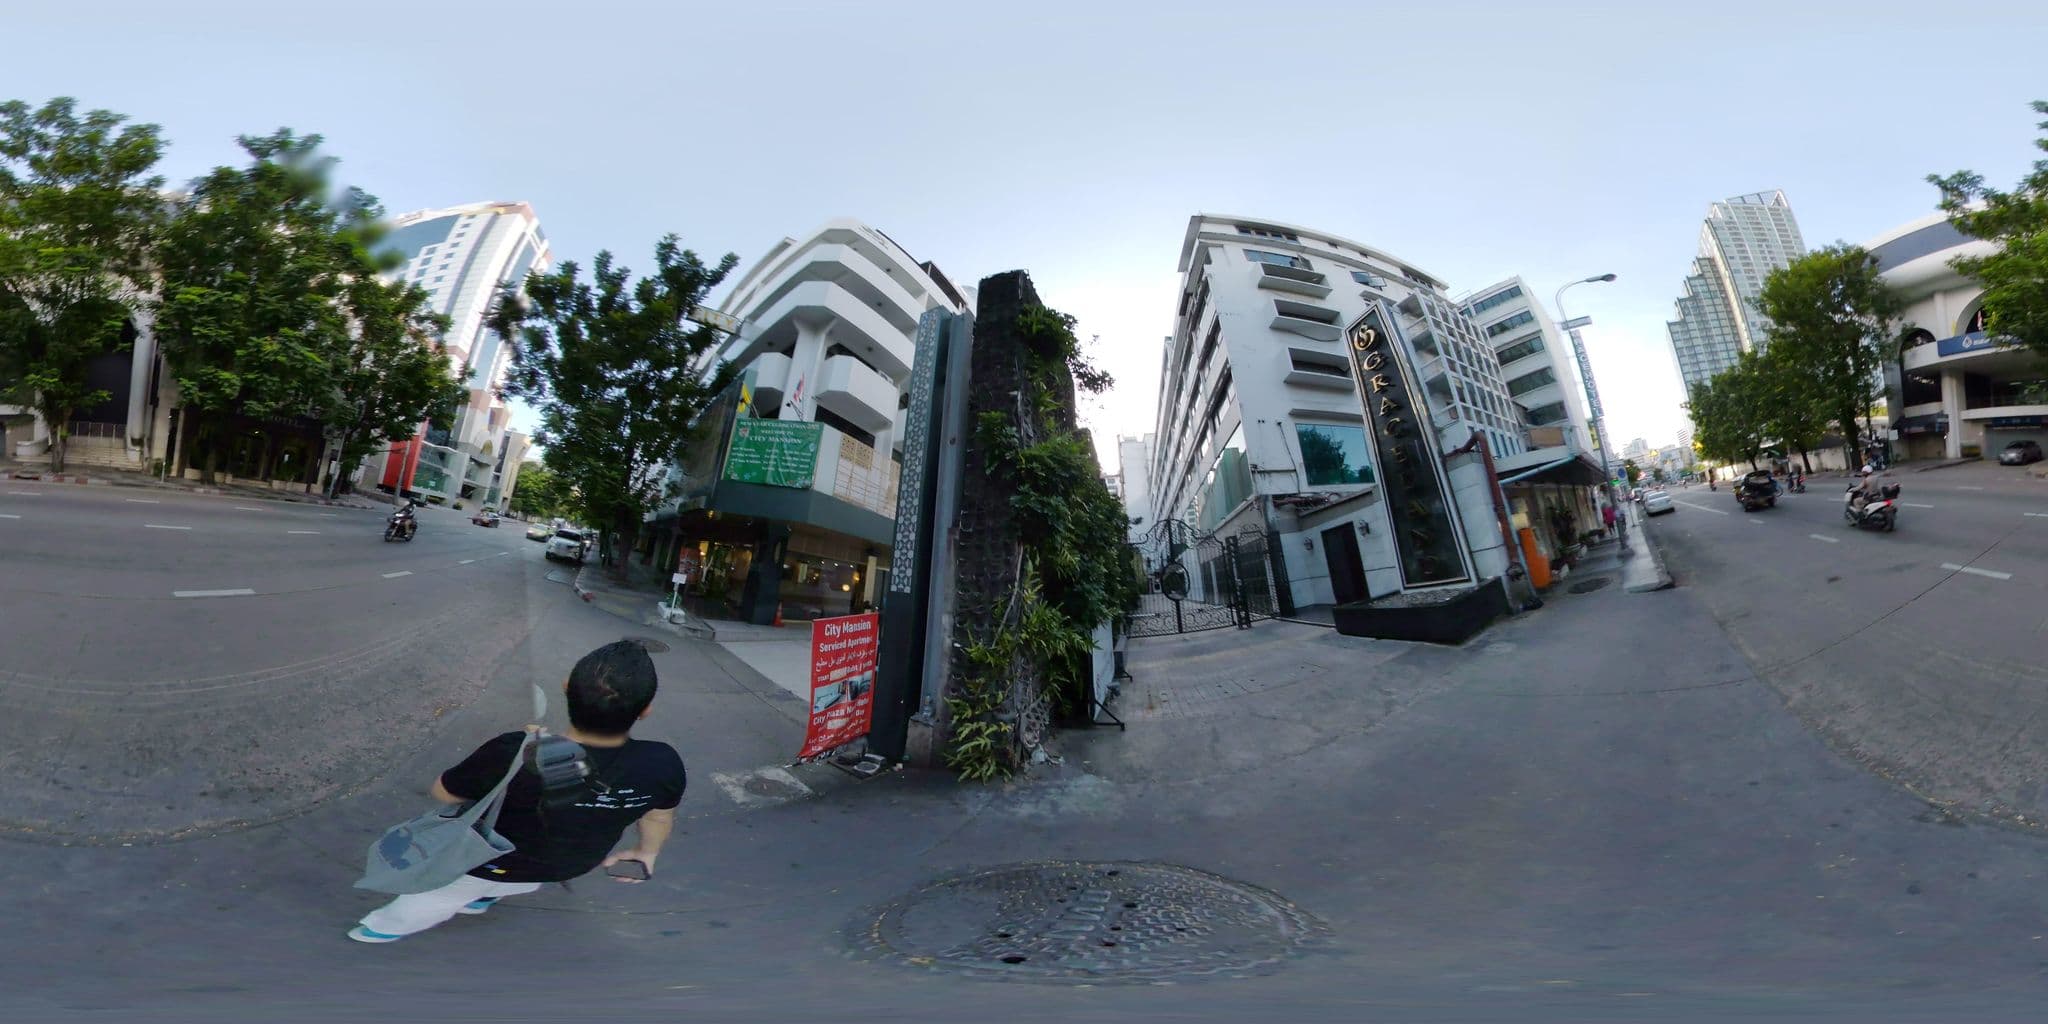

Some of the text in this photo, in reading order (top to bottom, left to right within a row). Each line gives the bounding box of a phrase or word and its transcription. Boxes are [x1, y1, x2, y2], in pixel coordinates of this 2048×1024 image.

[824, 620, 872, 638] City Mansion
[820, 640, 847, 653] Serviced
